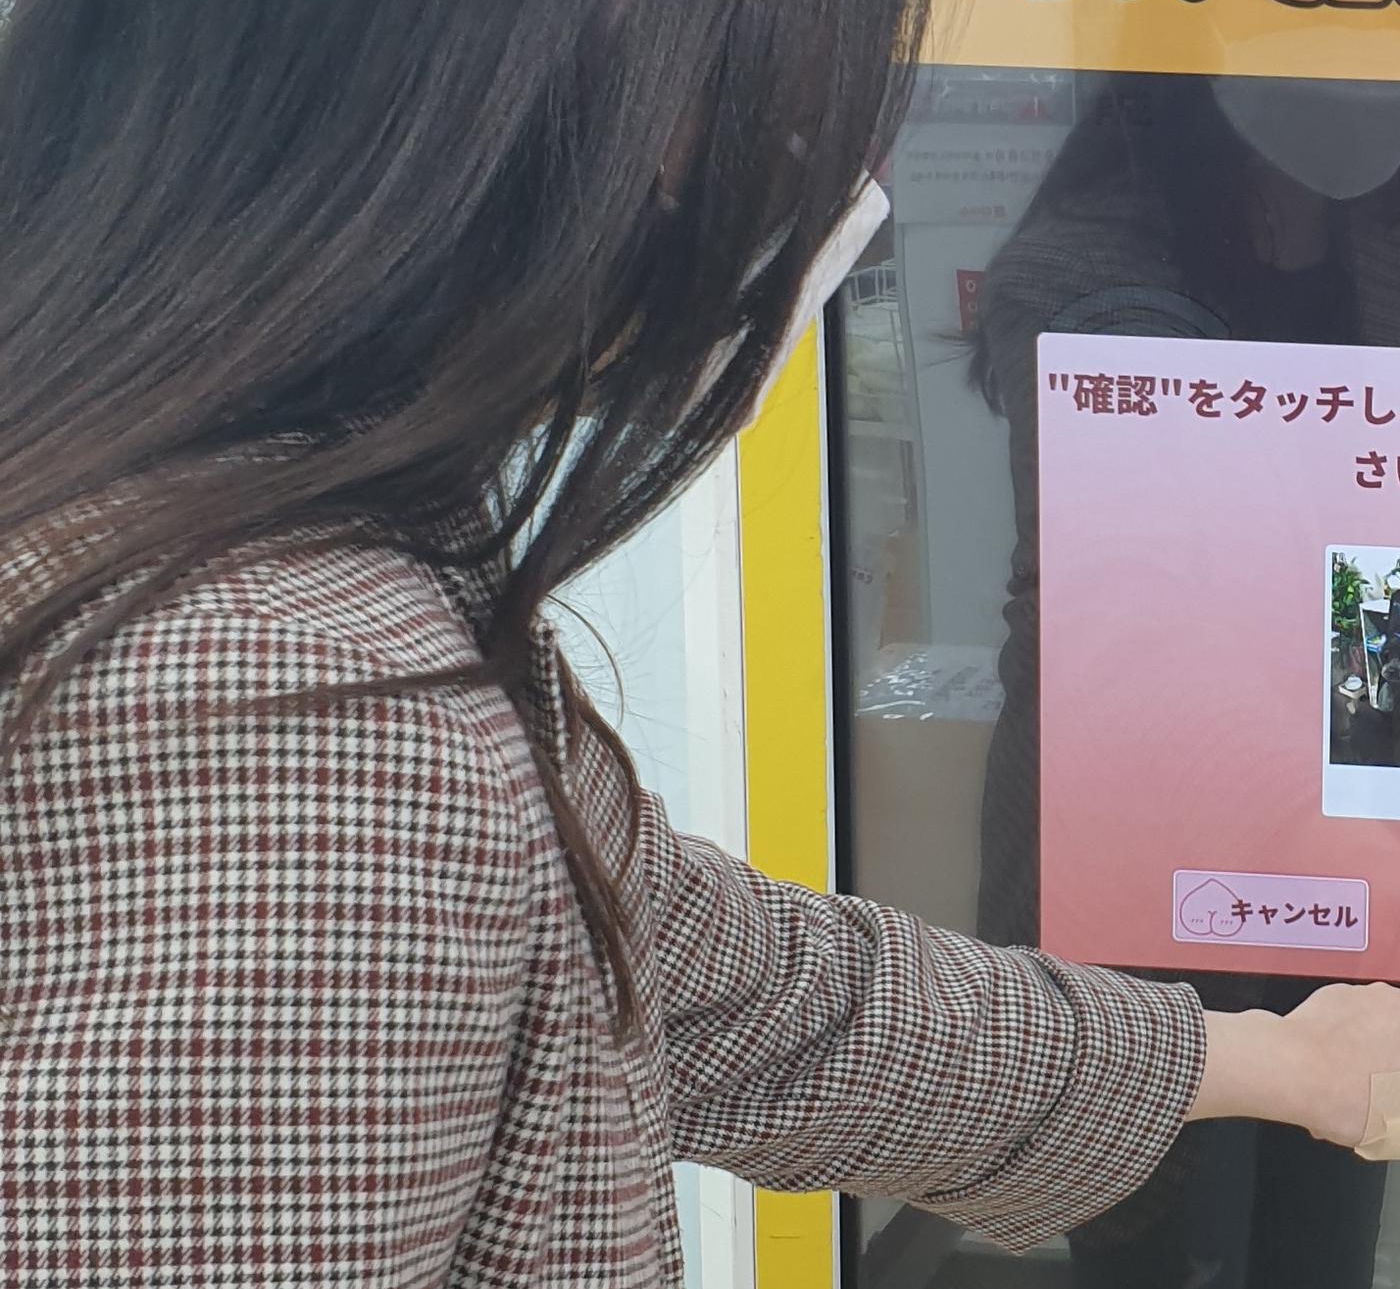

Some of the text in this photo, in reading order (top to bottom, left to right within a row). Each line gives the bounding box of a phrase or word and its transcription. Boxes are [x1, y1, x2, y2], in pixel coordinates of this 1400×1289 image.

[1230, 898, 1360, 929] キャンセル
